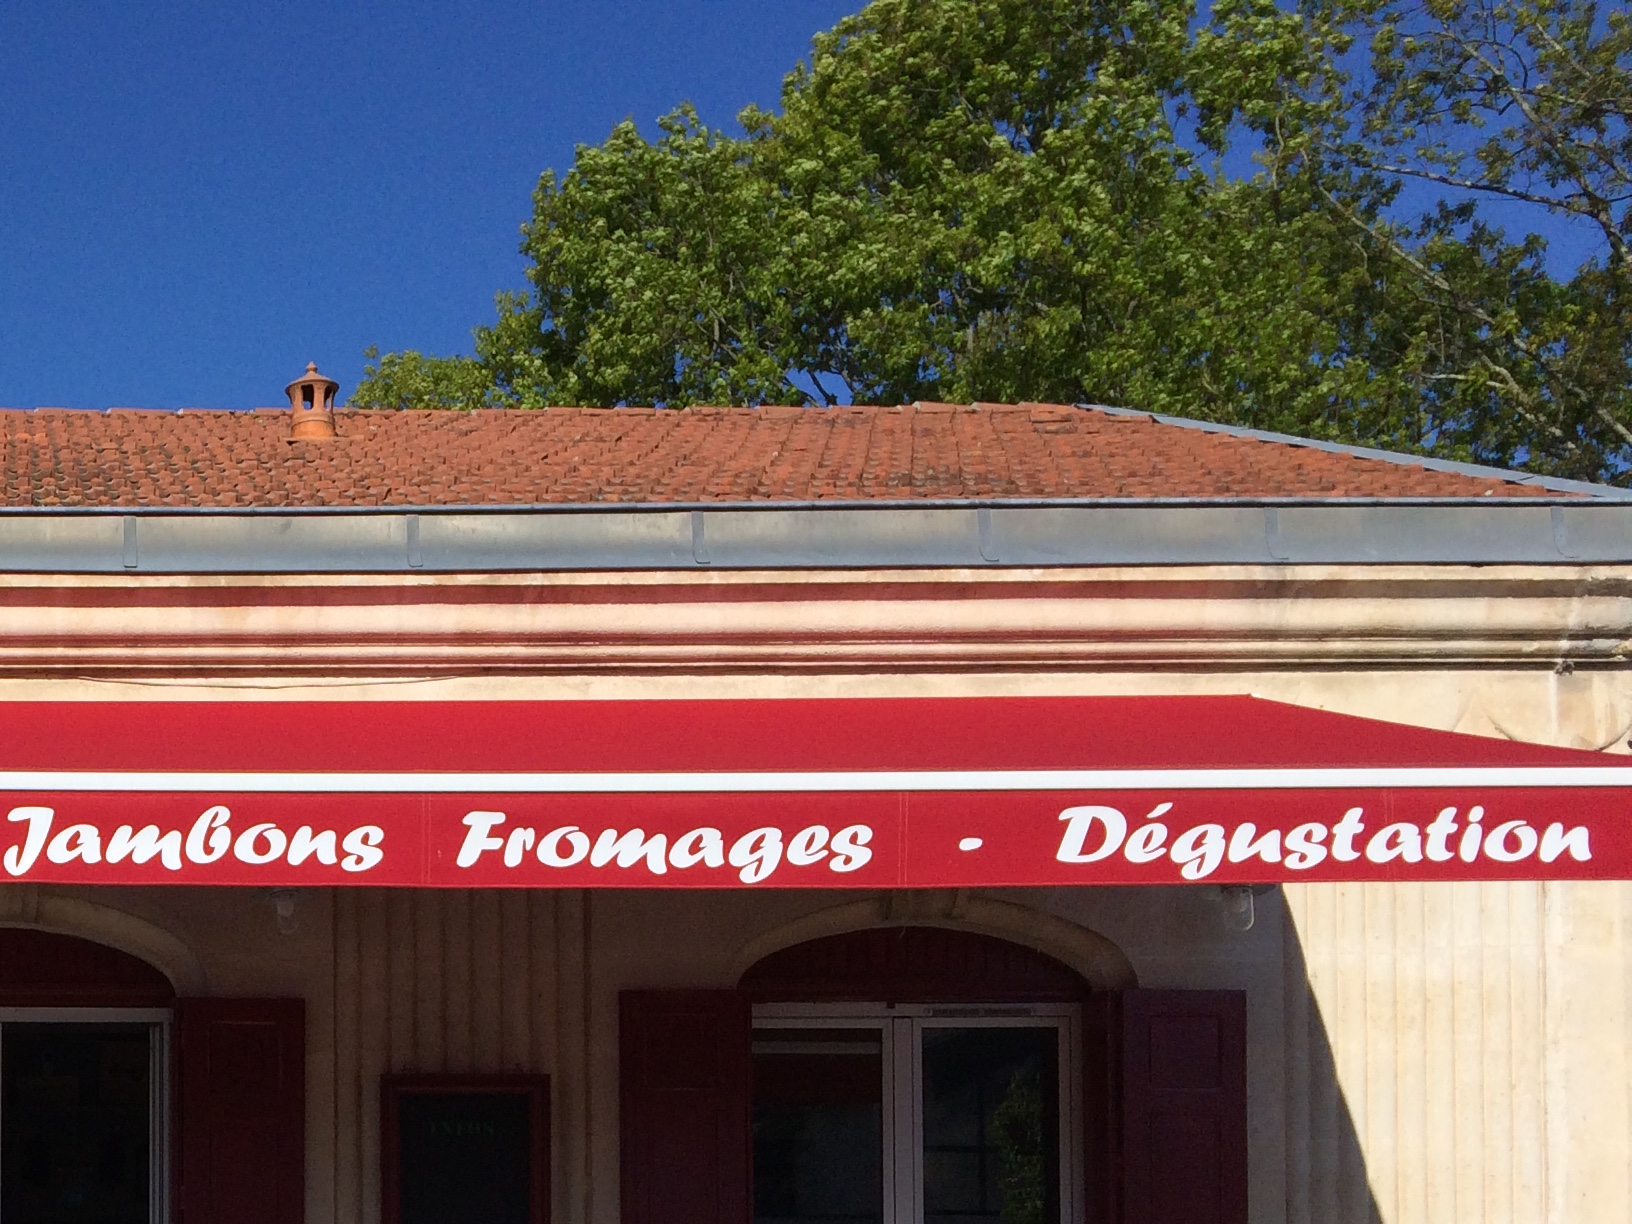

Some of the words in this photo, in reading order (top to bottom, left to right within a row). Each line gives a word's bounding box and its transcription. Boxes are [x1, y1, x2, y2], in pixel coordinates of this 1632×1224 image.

[4, 806, 384, 876] Jambons
[457, 811, 872, 883] Fromages
[1056, 803, 1592, 880] Dégustation
